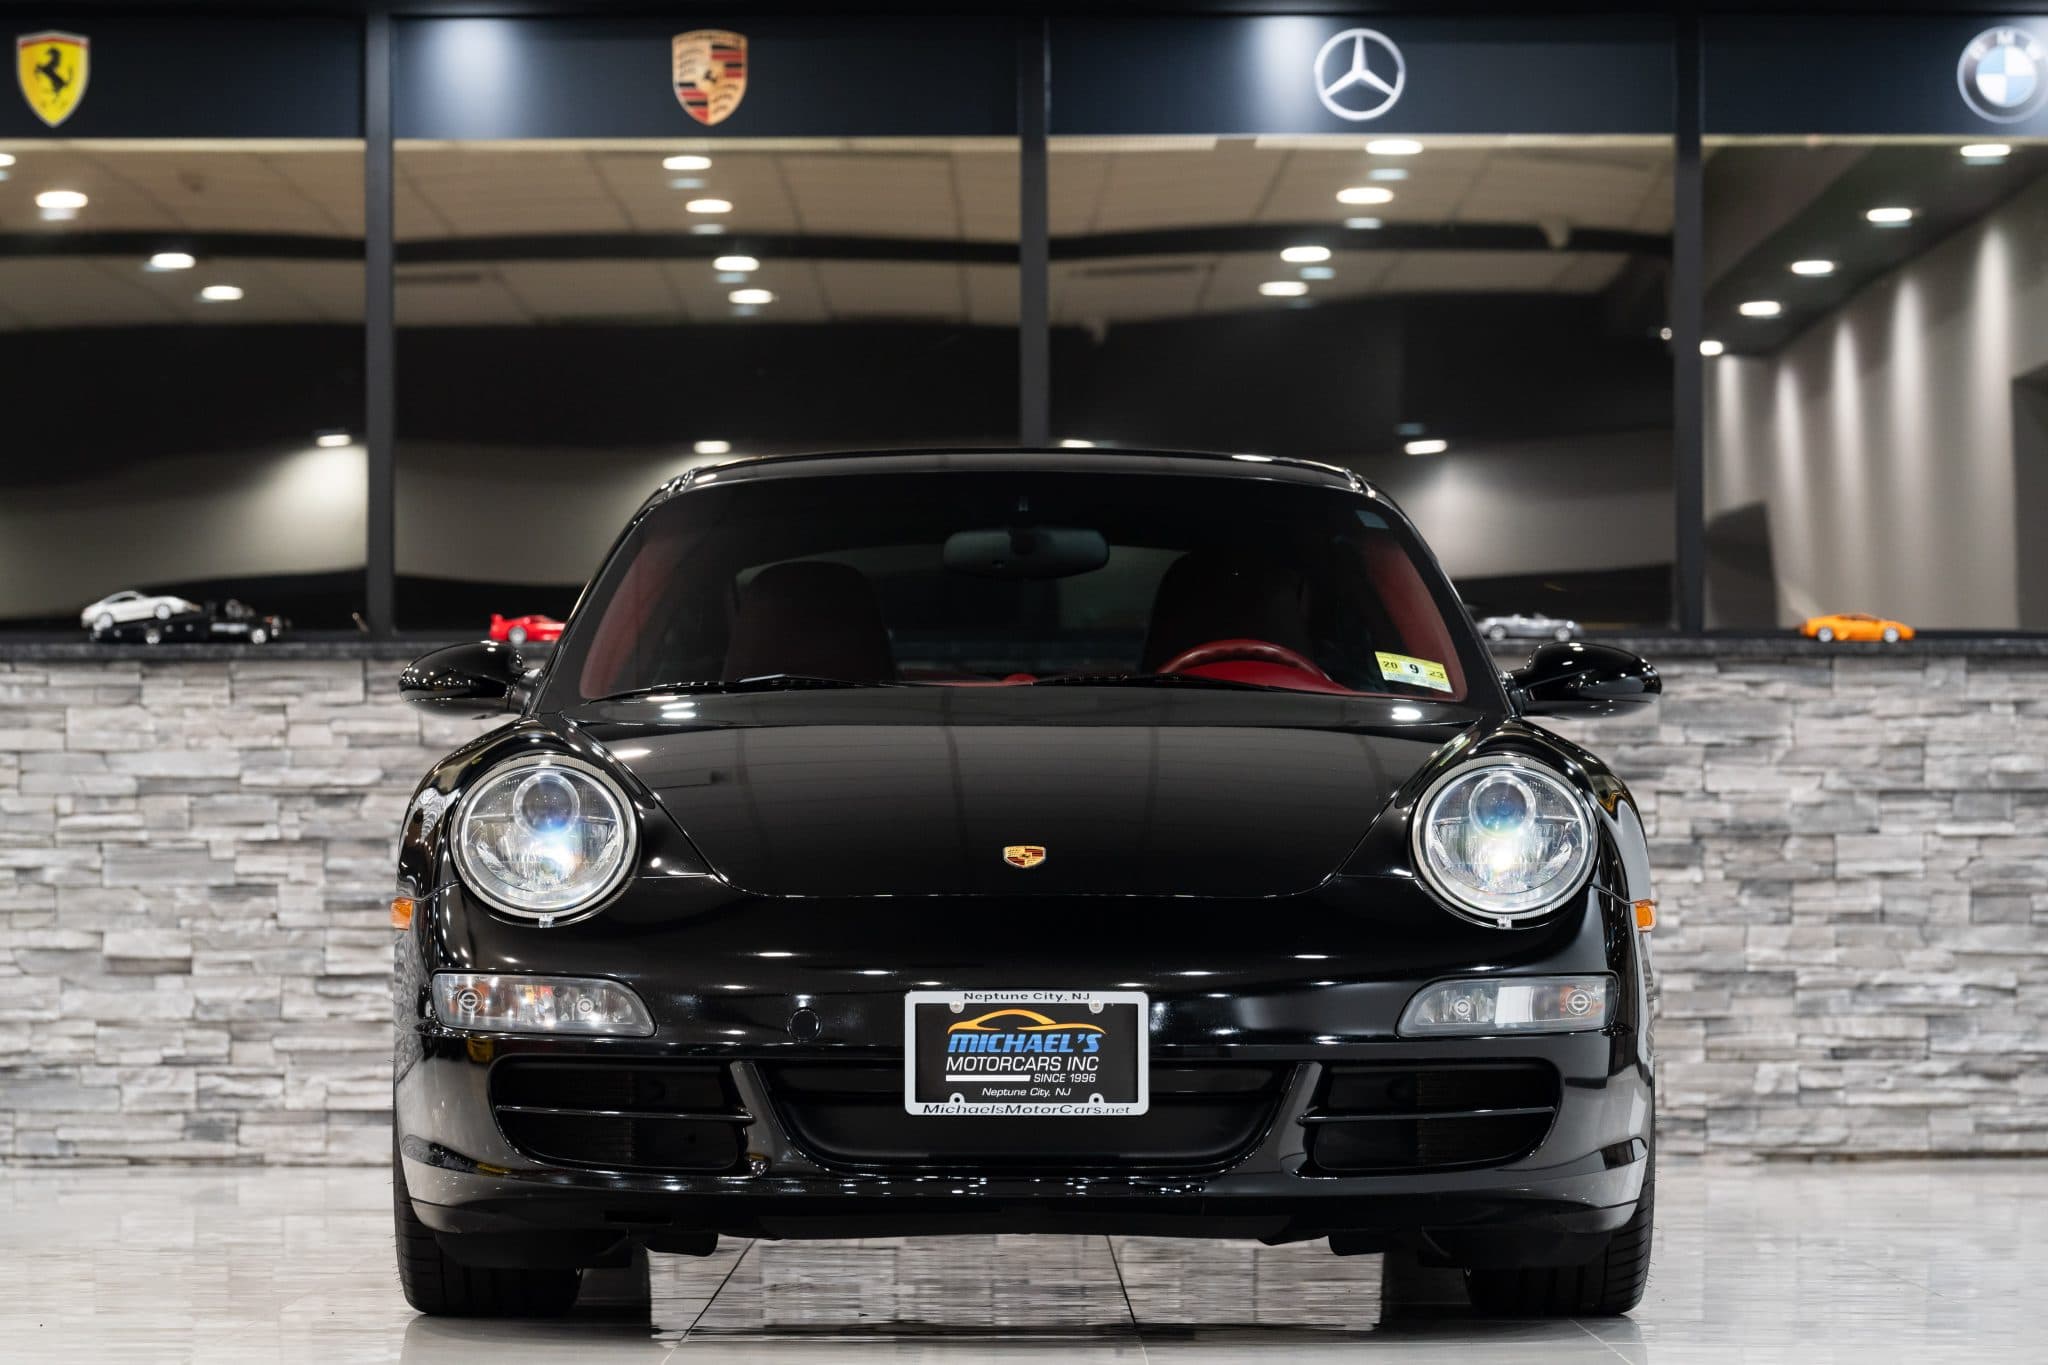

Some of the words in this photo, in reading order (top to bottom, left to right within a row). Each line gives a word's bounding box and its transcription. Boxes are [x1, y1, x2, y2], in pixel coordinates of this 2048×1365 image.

[1409, 663, 1419, 674] 9
[963, 992, 1029, 1002] Neptune
[1071, 992, 1090, 1000] NJ
[947, 1033, 1103, 1053] MICHAEL'S
[945, 1056, 1062, 1072] MOTORCARS
[1067, 1056, 1099, 1072] INC
[1033, 1073, 1066, 1083] SINCE
[1069, 1073, 1096, 1083] 1996
[982, 1087, 1027, 1098] Neptune
[1030, 1087, 1051, 1098] City,
[1055, 1087, 1072, 1096] NJ
[922, 1104, 1130, 1115] MichaelsMotorCars.net
